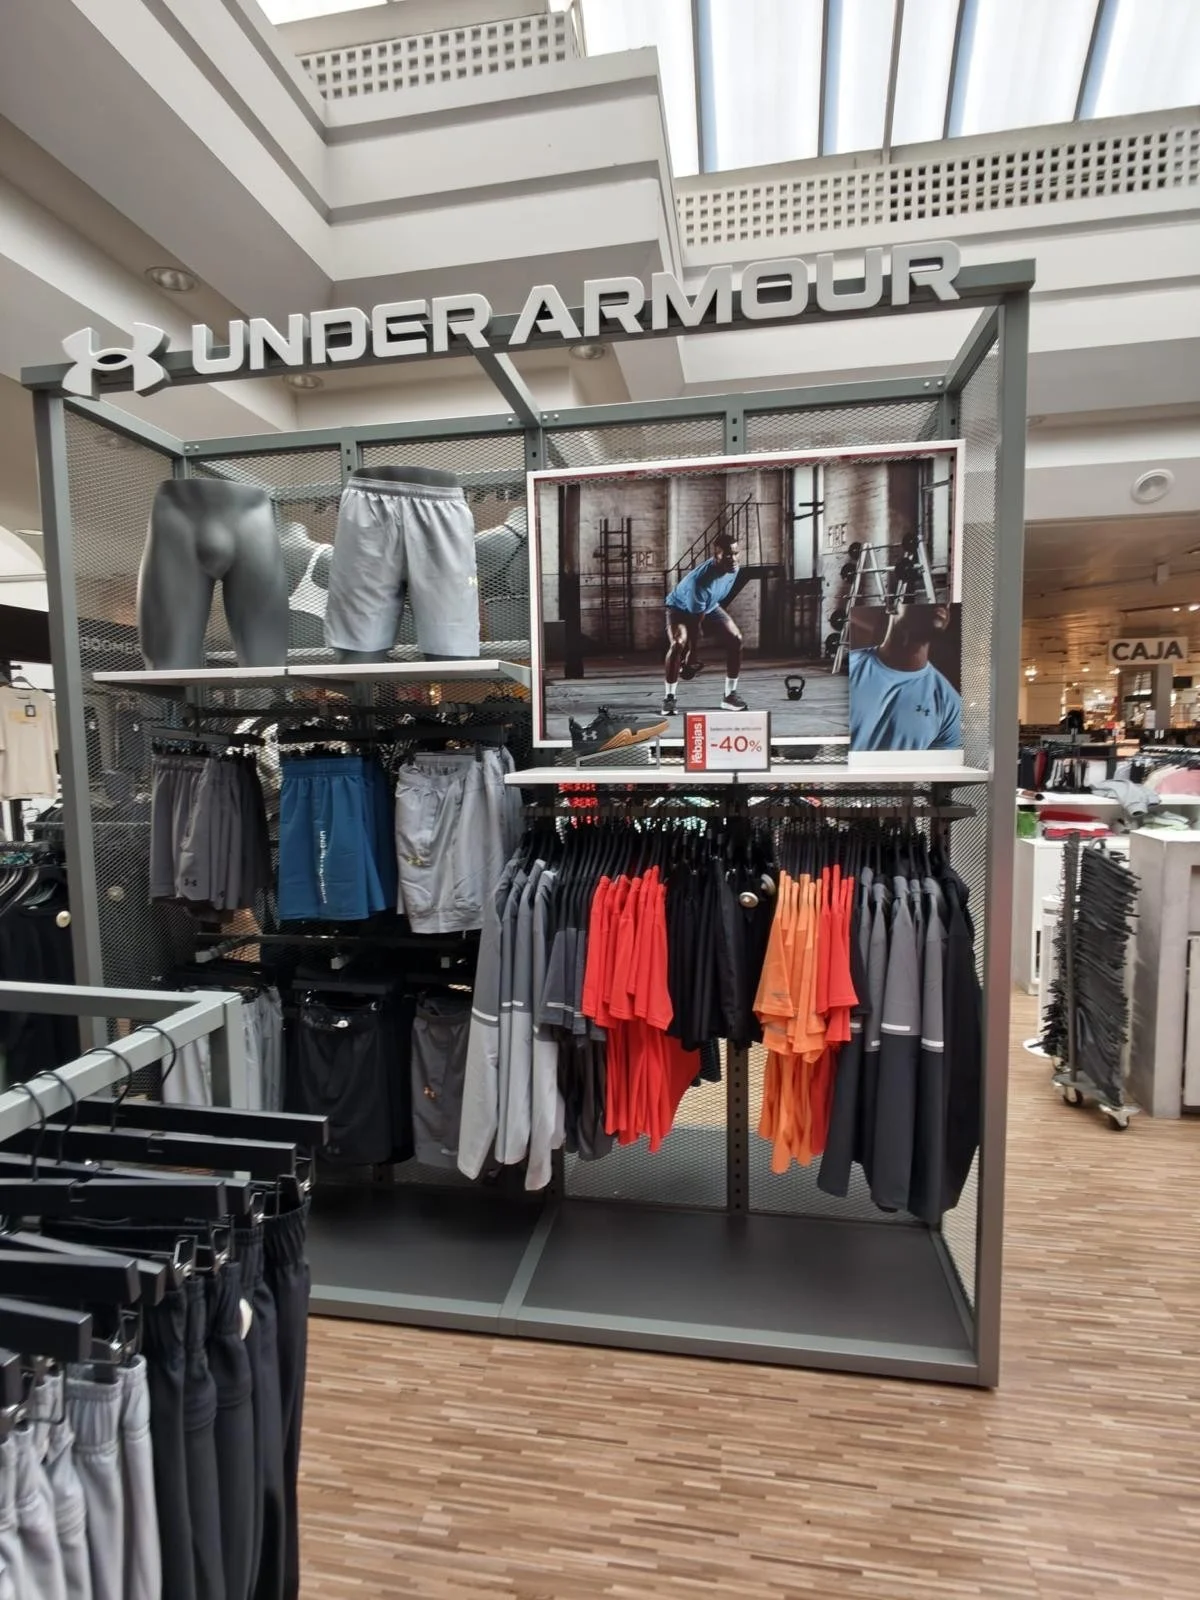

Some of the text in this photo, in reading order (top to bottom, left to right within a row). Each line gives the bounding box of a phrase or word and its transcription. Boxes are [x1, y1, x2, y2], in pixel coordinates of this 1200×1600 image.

[192, 240, 963, 375] UNDER ARMOUR
[1112, 640, 1184, 661] CAJA
[690, 722, 704, 764] rebajas
[710, 735, 763, 752] -40%
